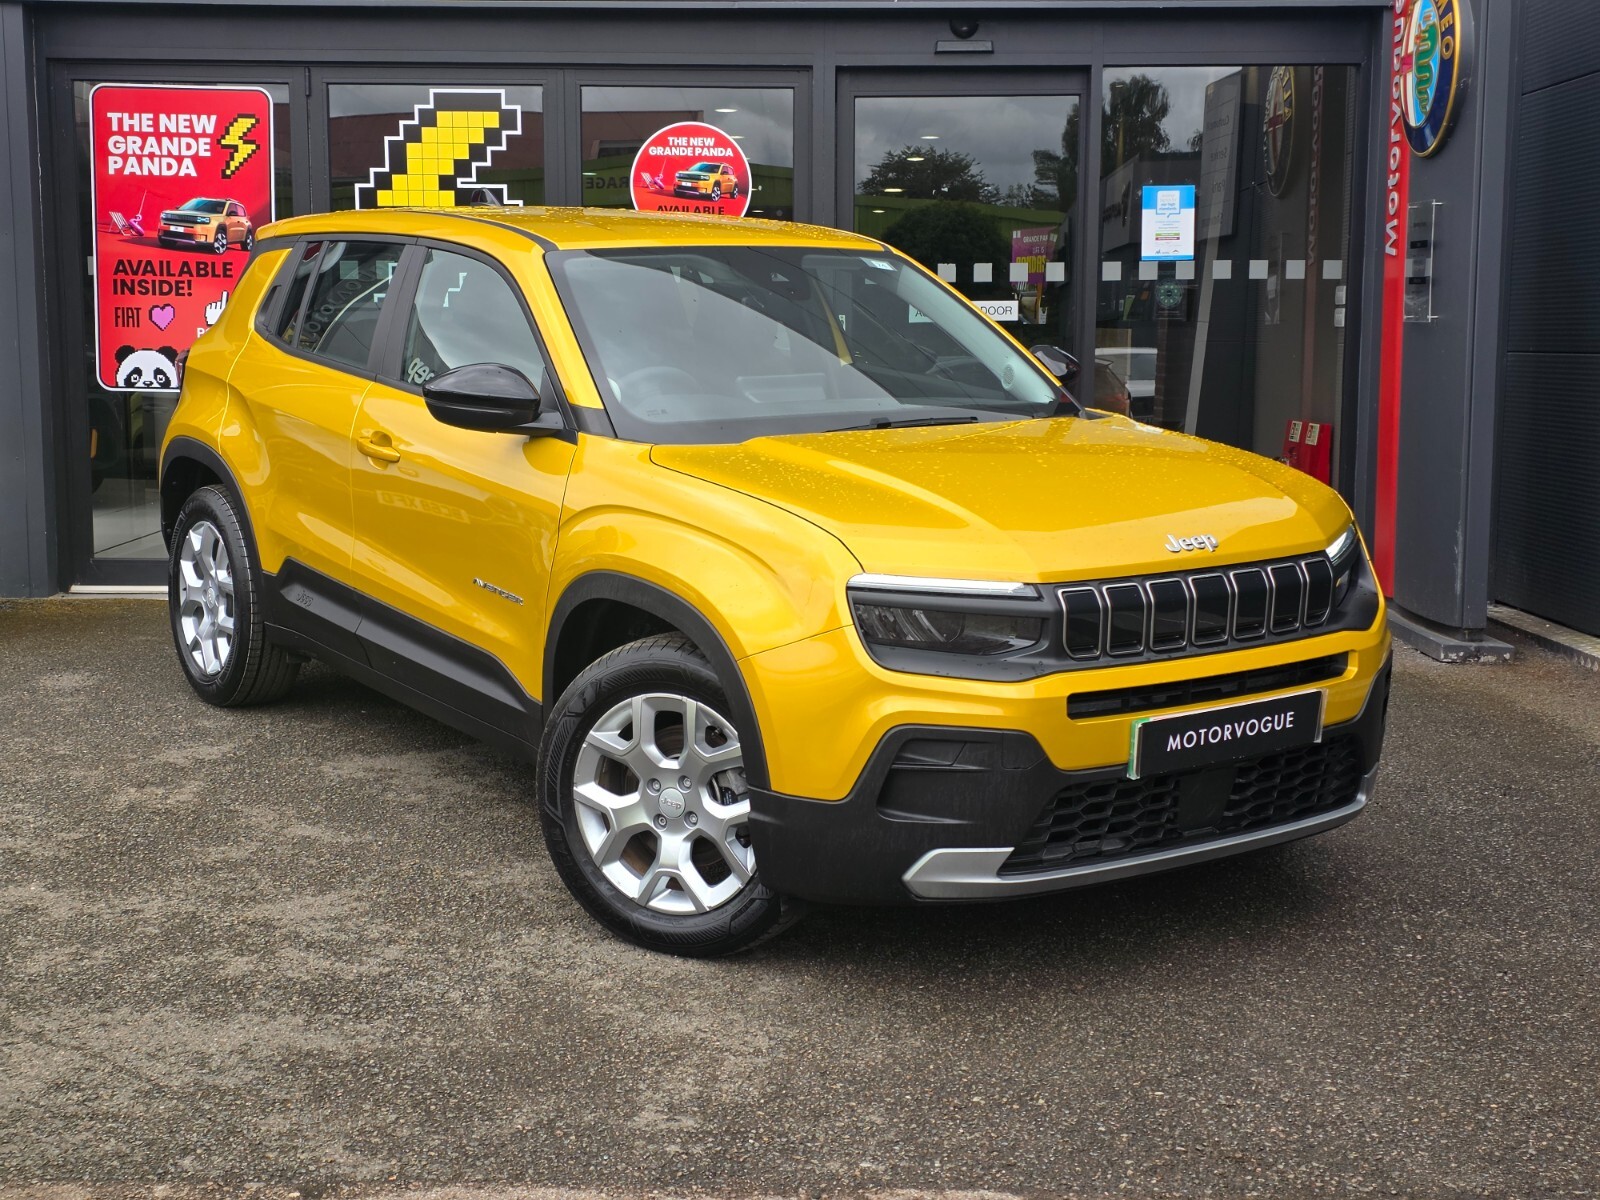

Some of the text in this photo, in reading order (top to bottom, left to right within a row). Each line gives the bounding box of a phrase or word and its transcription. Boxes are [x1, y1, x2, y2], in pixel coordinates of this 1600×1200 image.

[107, 112, 217, 134] THE NEW
[107, 135, 212, 157] GRANDE
[668, 136, 715, 147] THE NEW
[648, 147, 734, 157] GRANDE PANDA
[108, 156, 198, 177] PANDA
[112, 259, 234, 279] AVAILABLE
[112, 278, 194, 298] INSIDE!
[114, 306, 142, 328] FIAT
[980, 306, 1013, 316] DOOR
[1164, 533, 1219, 552] Jeep
[1166, 711, 1295, 752] MOTORVOGUE
[661, 797, 682, 810] Jeep
